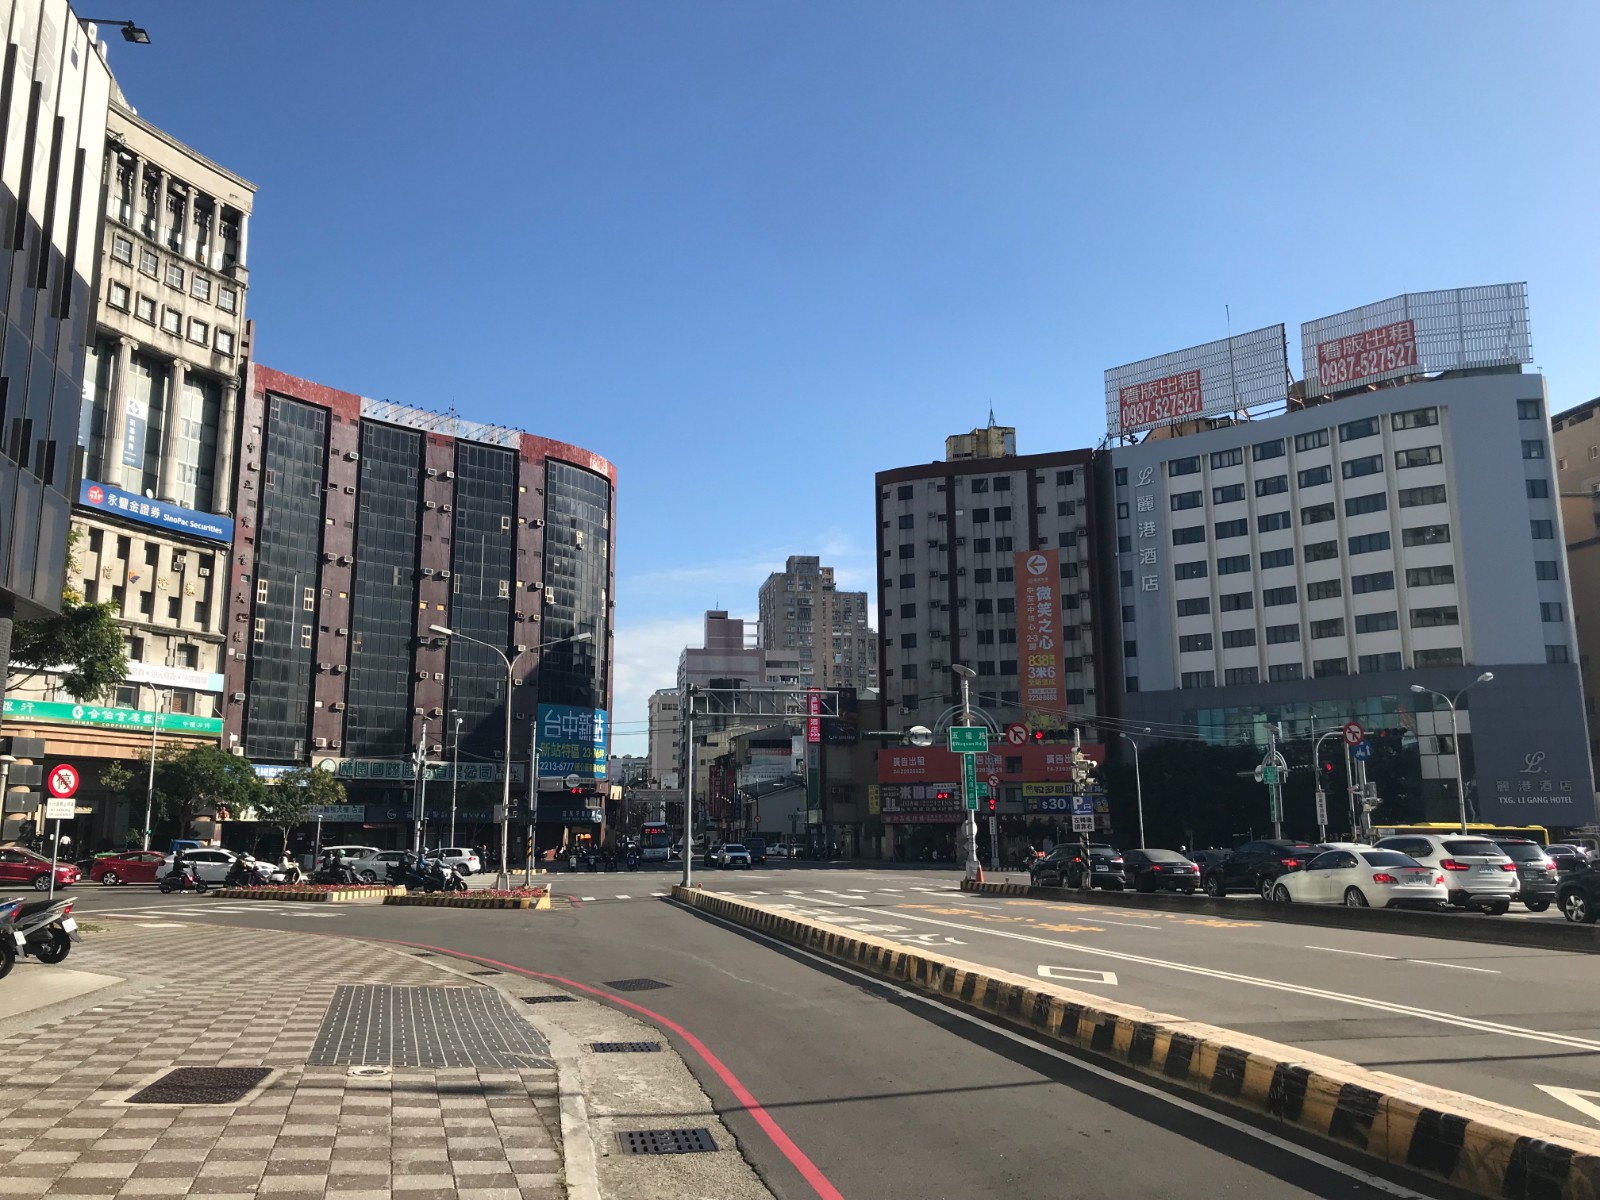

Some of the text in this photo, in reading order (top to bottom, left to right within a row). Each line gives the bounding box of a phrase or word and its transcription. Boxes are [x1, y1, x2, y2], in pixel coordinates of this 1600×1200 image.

[1321, 341, 1414, 386] 0937-527527
[1122, 389, 1200, 427] 0937-527527
[107, 493, 223, 534] 永豐金證券 SinoPac Securities
[1137, 494, 1159, 593] 麗港酒店
[1036, 586, 1054, 650] 微笑之心
[1028, 667, 1056, 679] 3米6
[545, 709, 605, 743] 台中新站
[952, 731, 986, 740] 五權路
[540, 743, 580, 759] 新站特區
[893, 756, 925, 767] 廣告出租
[976, 755, 1002, 765] 告出租
[1496, 780, 1572, 792] 麗港酒店
[1072, 796, 1084, 810] P
[1498, 796, 1516, 804] TXG.
[1526, 796, 1549, 804] GANG
[1550, 796, 1573, 804] HOTEL
